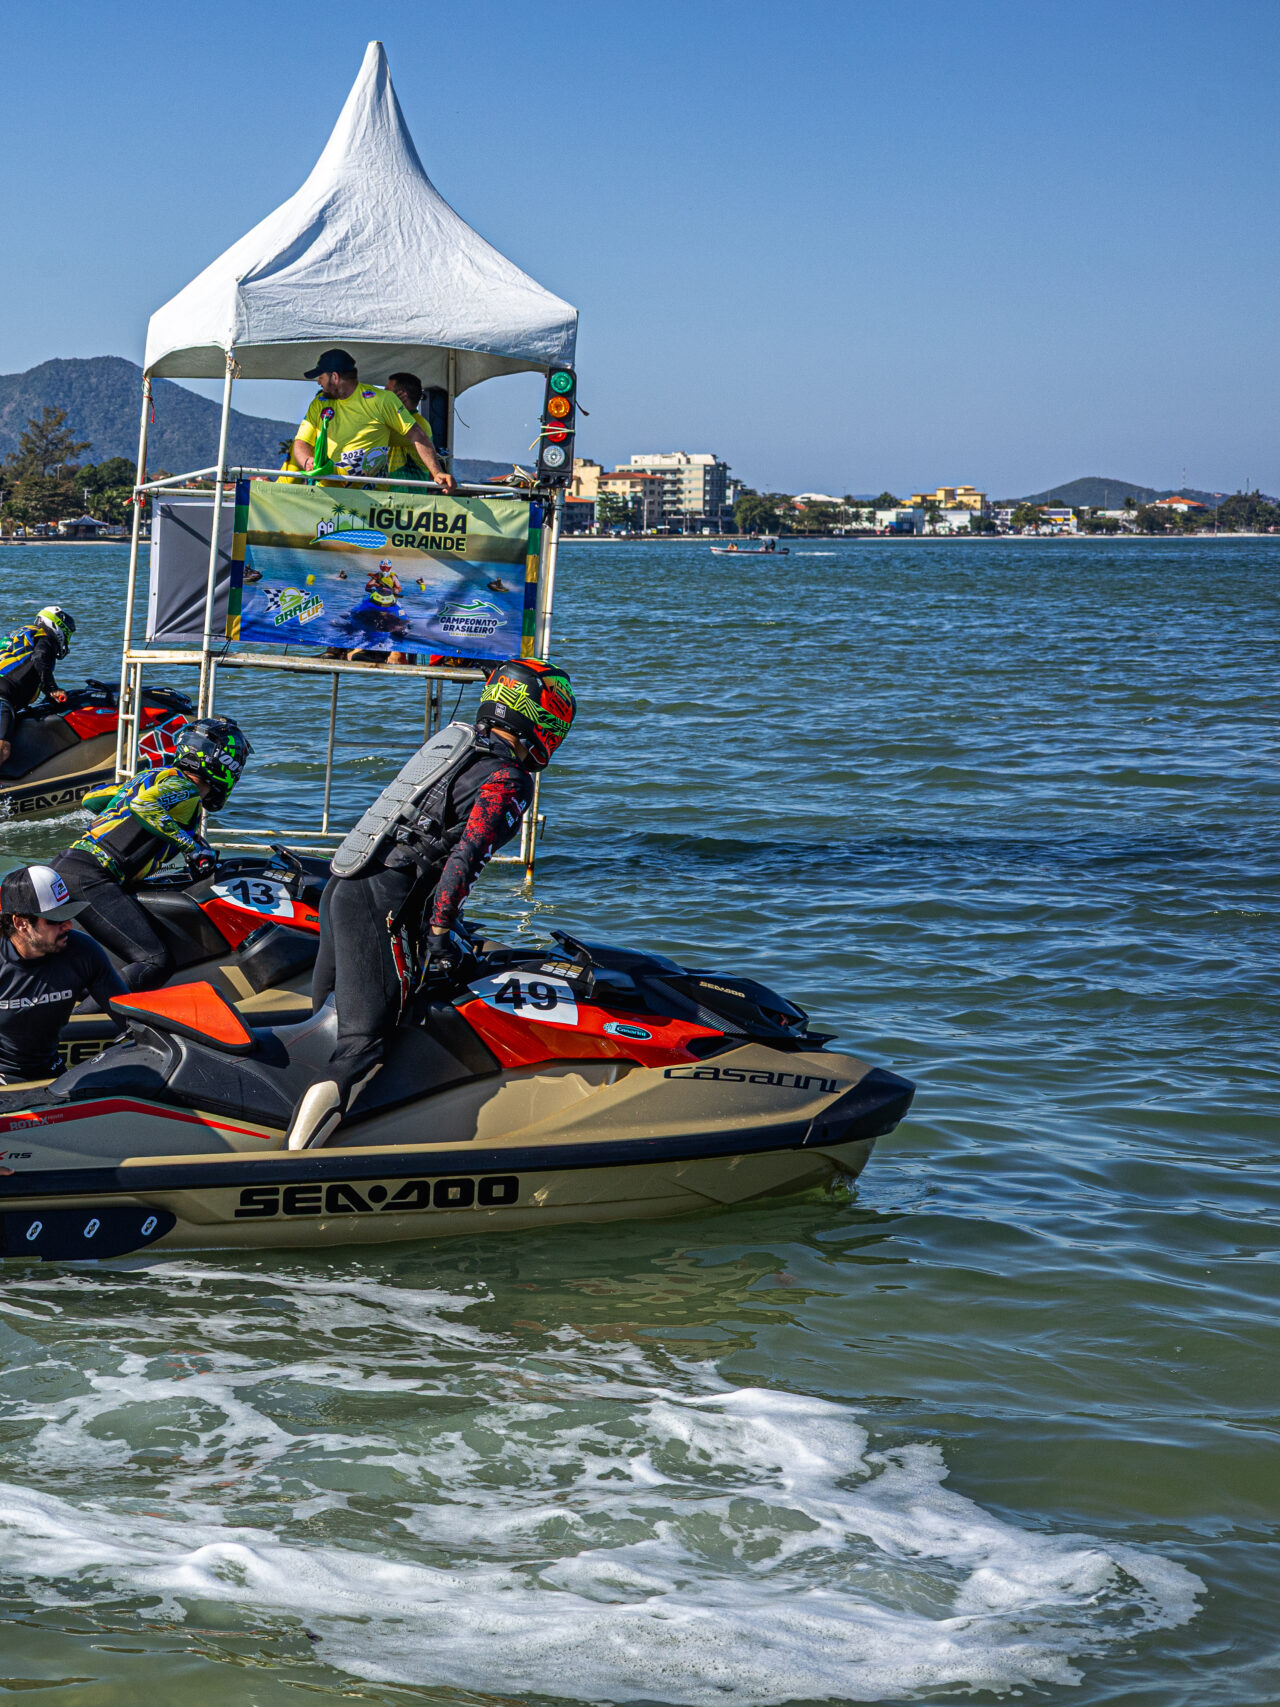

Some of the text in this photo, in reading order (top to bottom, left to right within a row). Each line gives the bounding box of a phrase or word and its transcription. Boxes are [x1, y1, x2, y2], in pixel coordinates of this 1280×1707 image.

[369, 507, 467, 534] IGUABA
[391, 533, 466, 552] GRANDE
[275, 595, 322, 626] BRAZIL
[299, 603, 323, 622] CUP
[440, 616, 498, 627] CAMPEONATO
[443, 624, 494, 634] BRASILEIRO
[232, 880, 275, 905] 13
[494, 978, 558, 1010] 49
[9, 1116, 50, 1131] ROTAX
